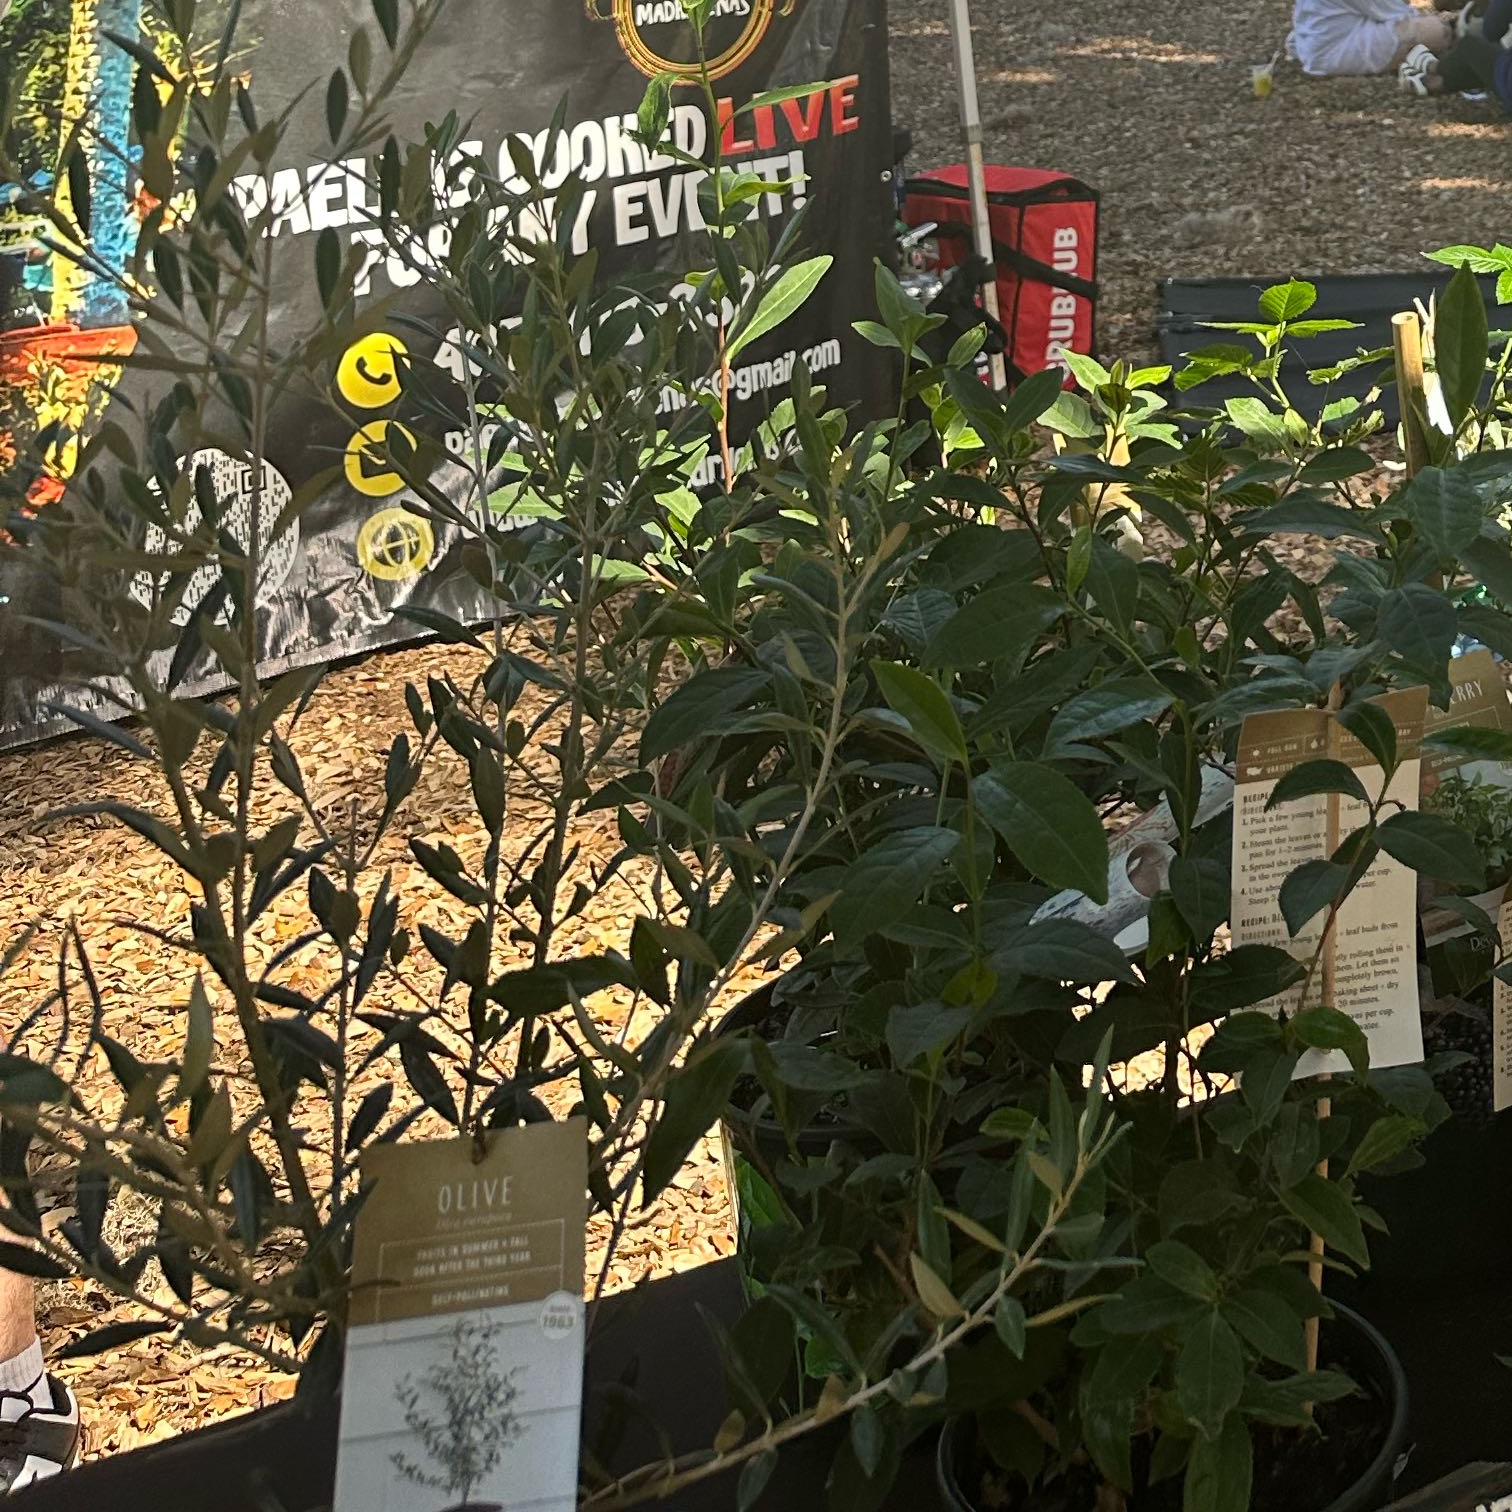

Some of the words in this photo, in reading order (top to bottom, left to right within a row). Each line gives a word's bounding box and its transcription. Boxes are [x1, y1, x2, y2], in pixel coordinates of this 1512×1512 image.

[716, 75, 860, 156] LIVE
[1043, 226, 1079, 381] RUBUB
[1241, 916, 1268, 928] RECIPE:
[1357, 960, 1368, 969] Let
[1370, 958, 1389, 967] them
[1387, 981, 1399, 990] dry
[438, 1176, 514, 1214] OLIVE
